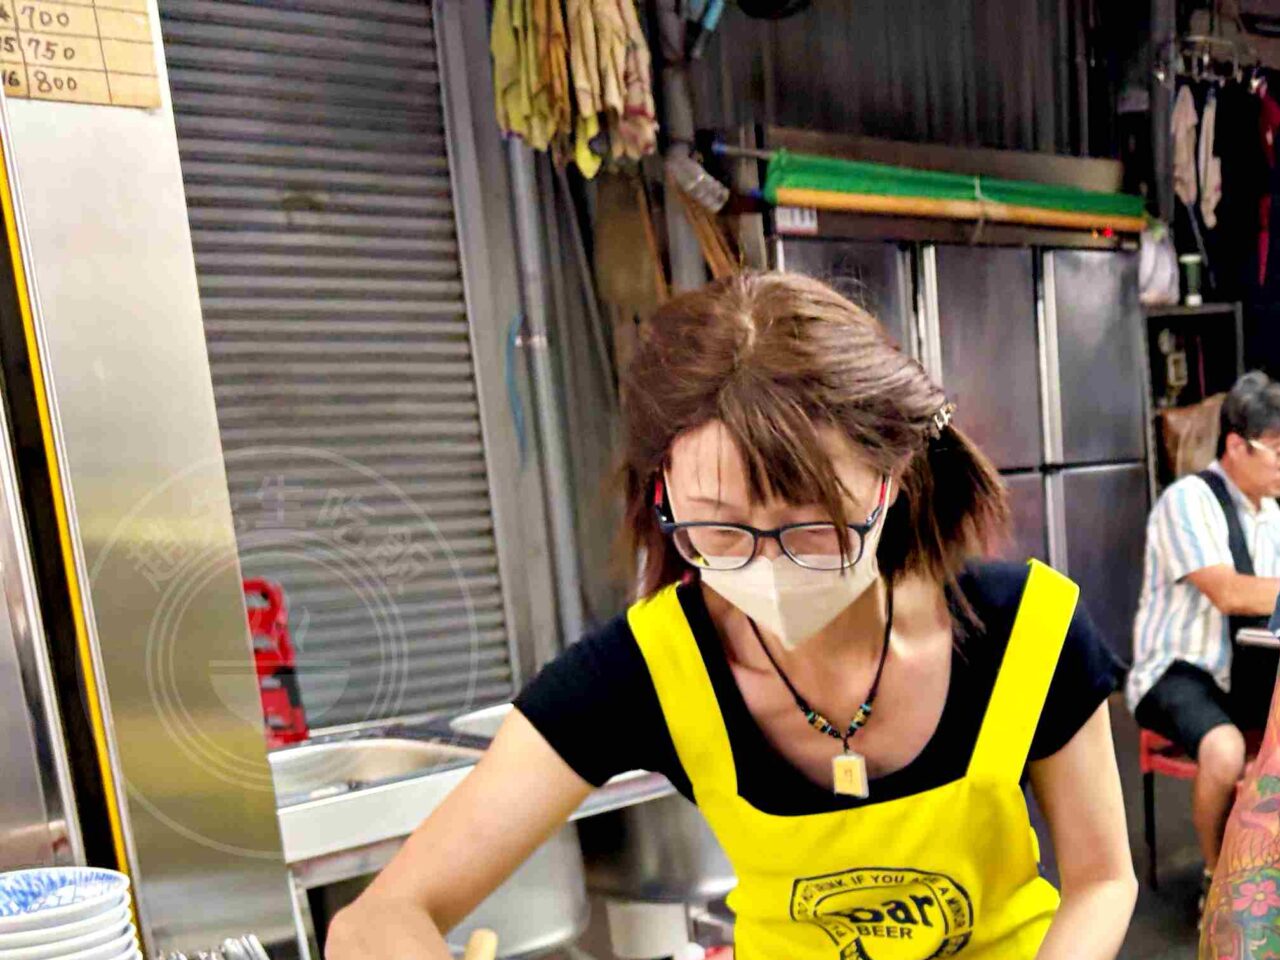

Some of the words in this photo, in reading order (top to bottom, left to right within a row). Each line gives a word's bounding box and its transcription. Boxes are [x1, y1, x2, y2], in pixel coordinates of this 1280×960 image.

[20, 5, 70, 30] 700
[28, 37, 76, 61] 750
[33, 70, 78, 94] 800
[852, 875, 865, 887] IF
[870, 873, 905, 885] YOU
[856, 924, 914, 940] BEER
